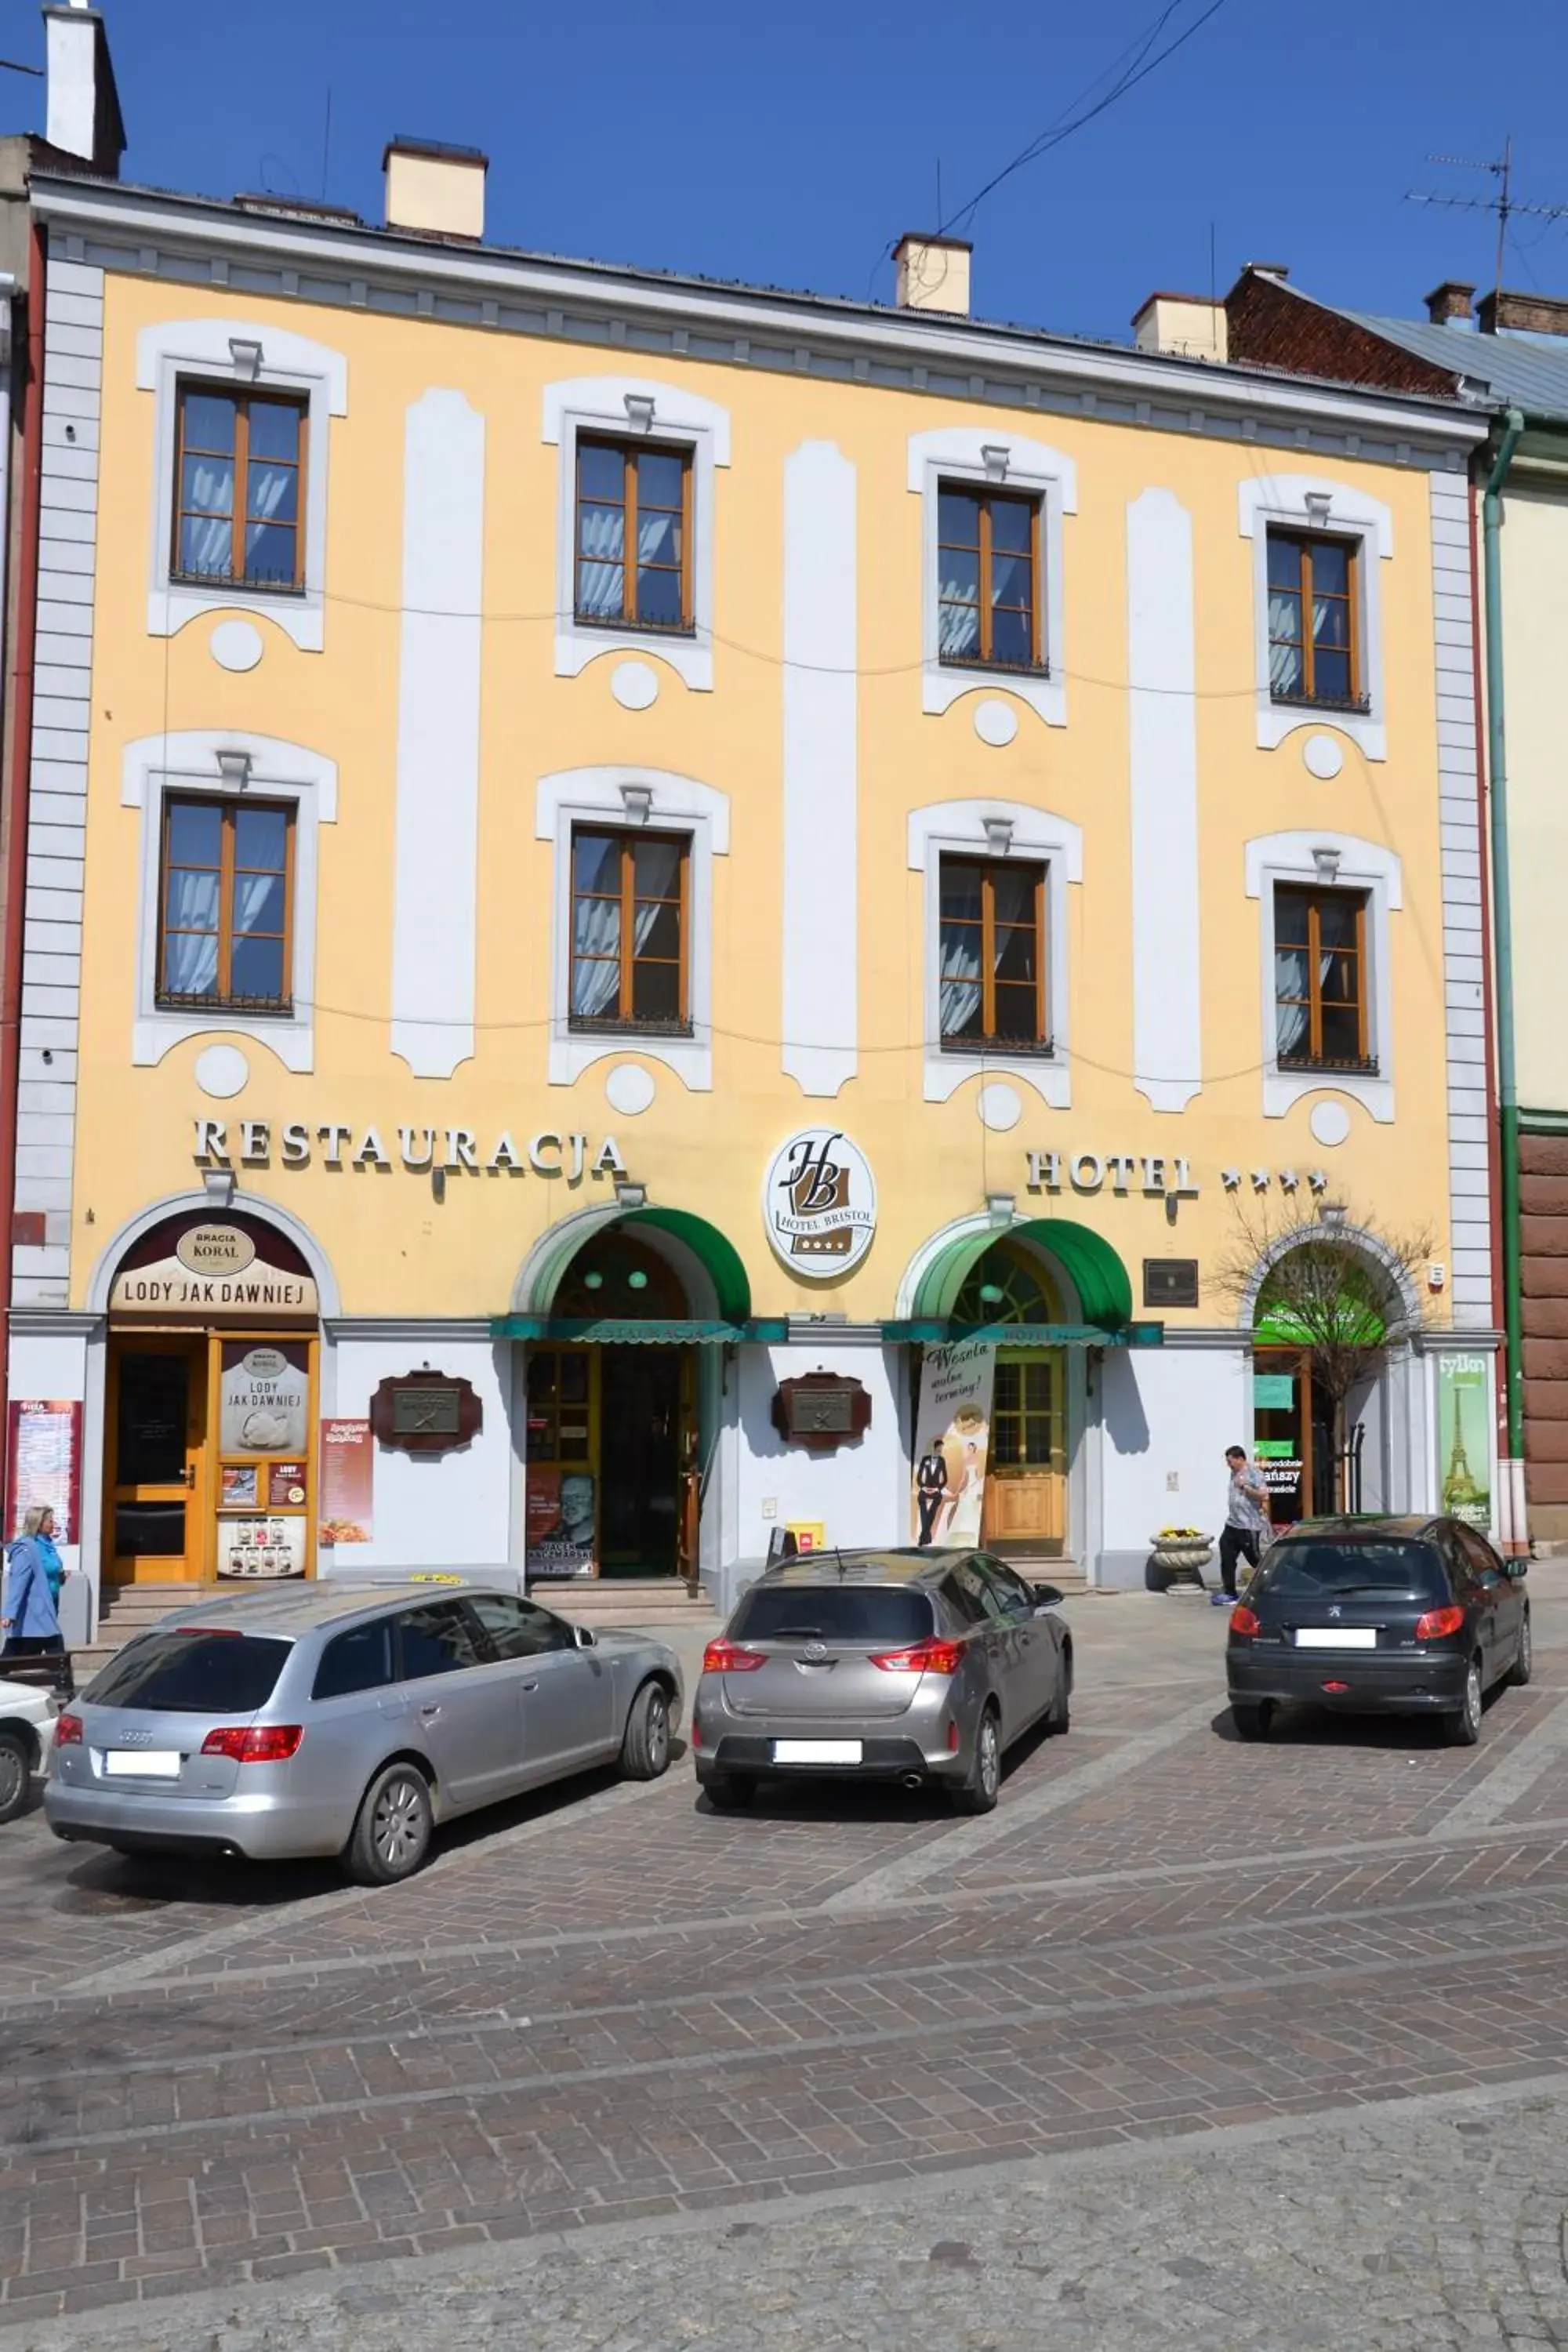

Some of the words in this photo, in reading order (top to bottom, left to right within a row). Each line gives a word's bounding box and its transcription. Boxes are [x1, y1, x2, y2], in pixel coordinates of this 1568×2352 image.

[194, 1119, 628, 1185] RESTAURACJA
[1026, 1152, 1200, 1193] HOTEL
[781, 1216, 821, 1231] HOTEL
[824, 1210, 873, 1226] BRISTOL
[196, 1233, 236, 1243] BRACIA
[194, 1246, 238, 1258] KORAL
[125, 1282, 172, 1300] LODY
[180, 1283, 214, 1301] JAK
[221, 1284, 304, 1304] DAWNIEJ
[250, 1382, 278, 1393] LODY
[228, 1396, 248, 1406] JAK
[252, 1396, 301, 1406] DAWNIEJ
